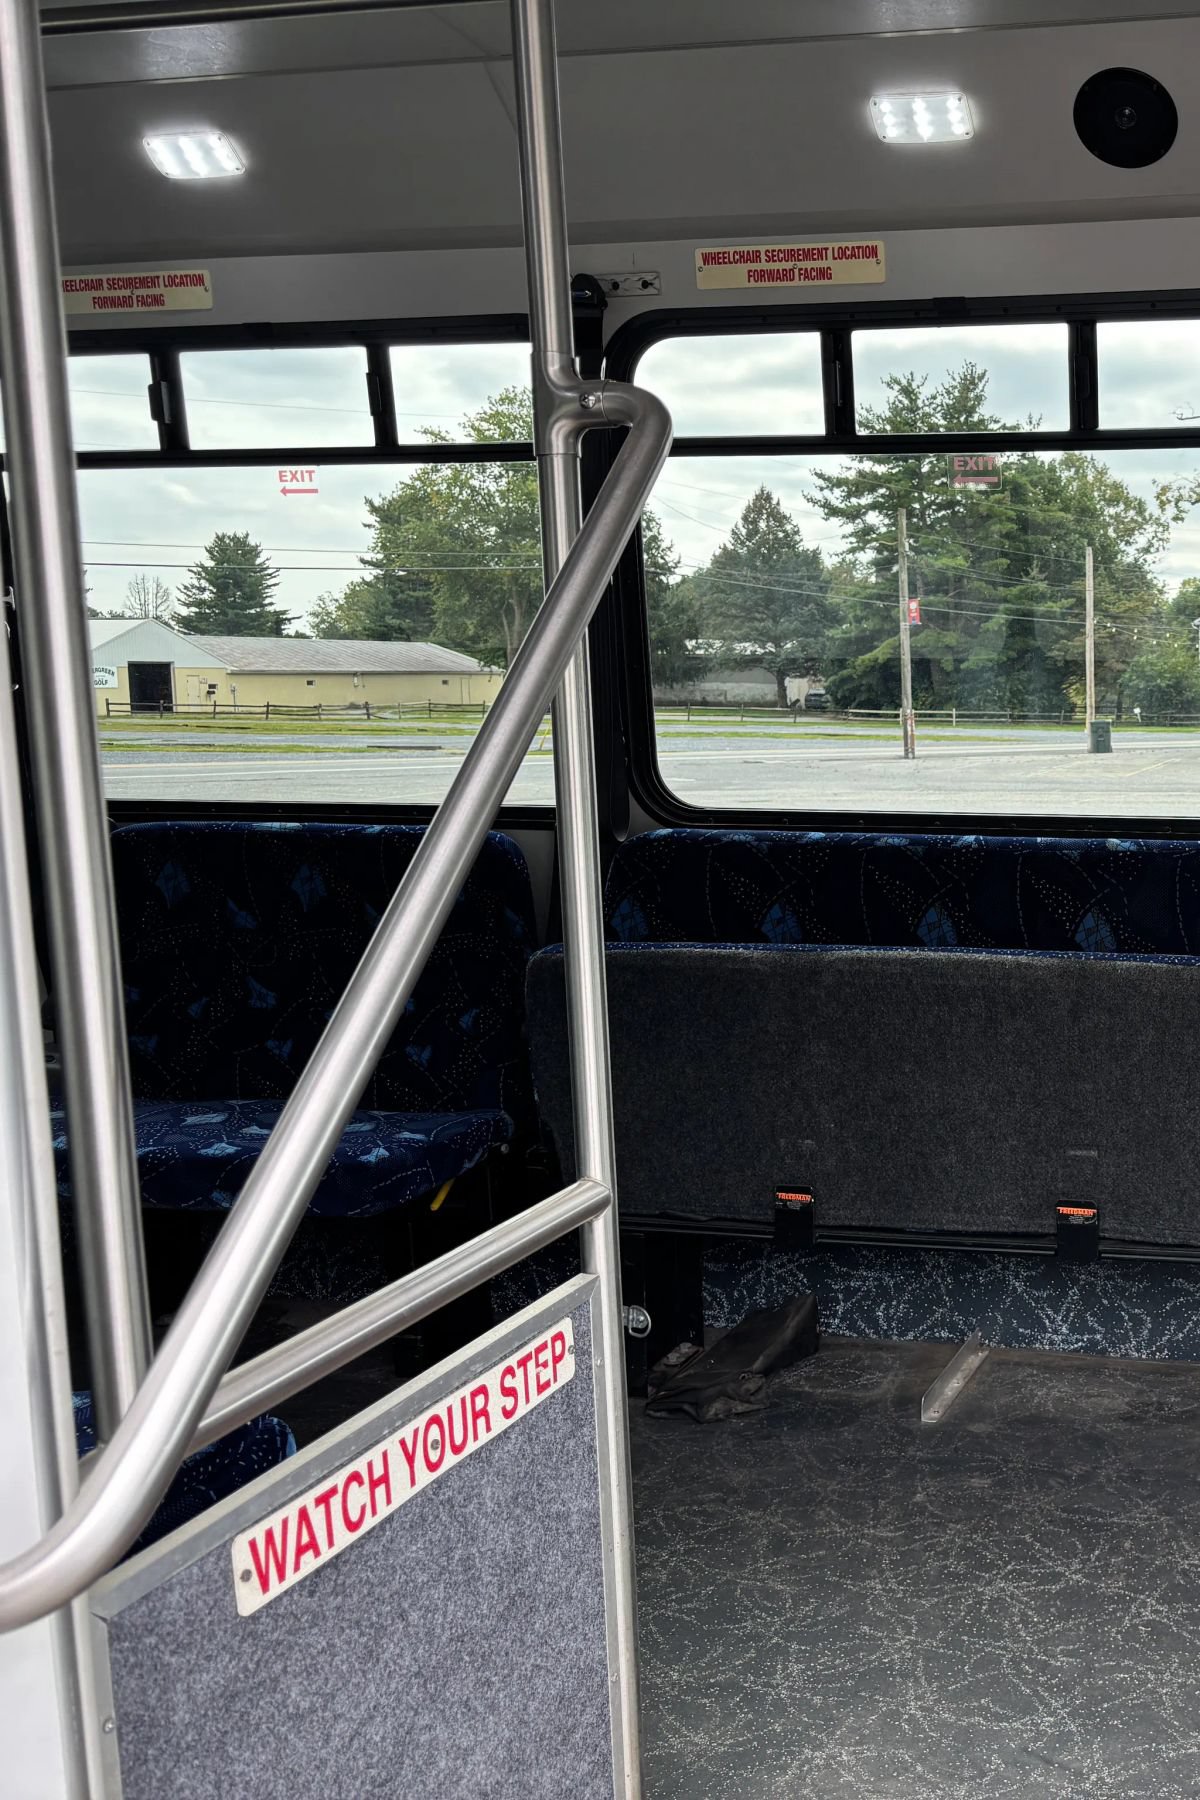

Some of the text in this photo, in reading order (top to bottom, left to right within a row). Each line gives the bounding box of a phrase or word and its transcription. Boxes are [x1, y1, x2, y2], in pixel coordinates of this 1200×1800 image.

[701, 245, 878, 266] WHEELCHAIR SECUREMENT LOCATION
[62, 273, 205, 293] EELCHAIR SECUREMENT LOCATION
[747, 266, 832, 283] FORWARD FACING
[92, 293, 165, 309] FORWARD FACING
[953, 456, 993, 471] EXIT
[278, 469, 316, 483] EXIT
[247, 1330, 566, 1595] WATCH YOUR STEP
